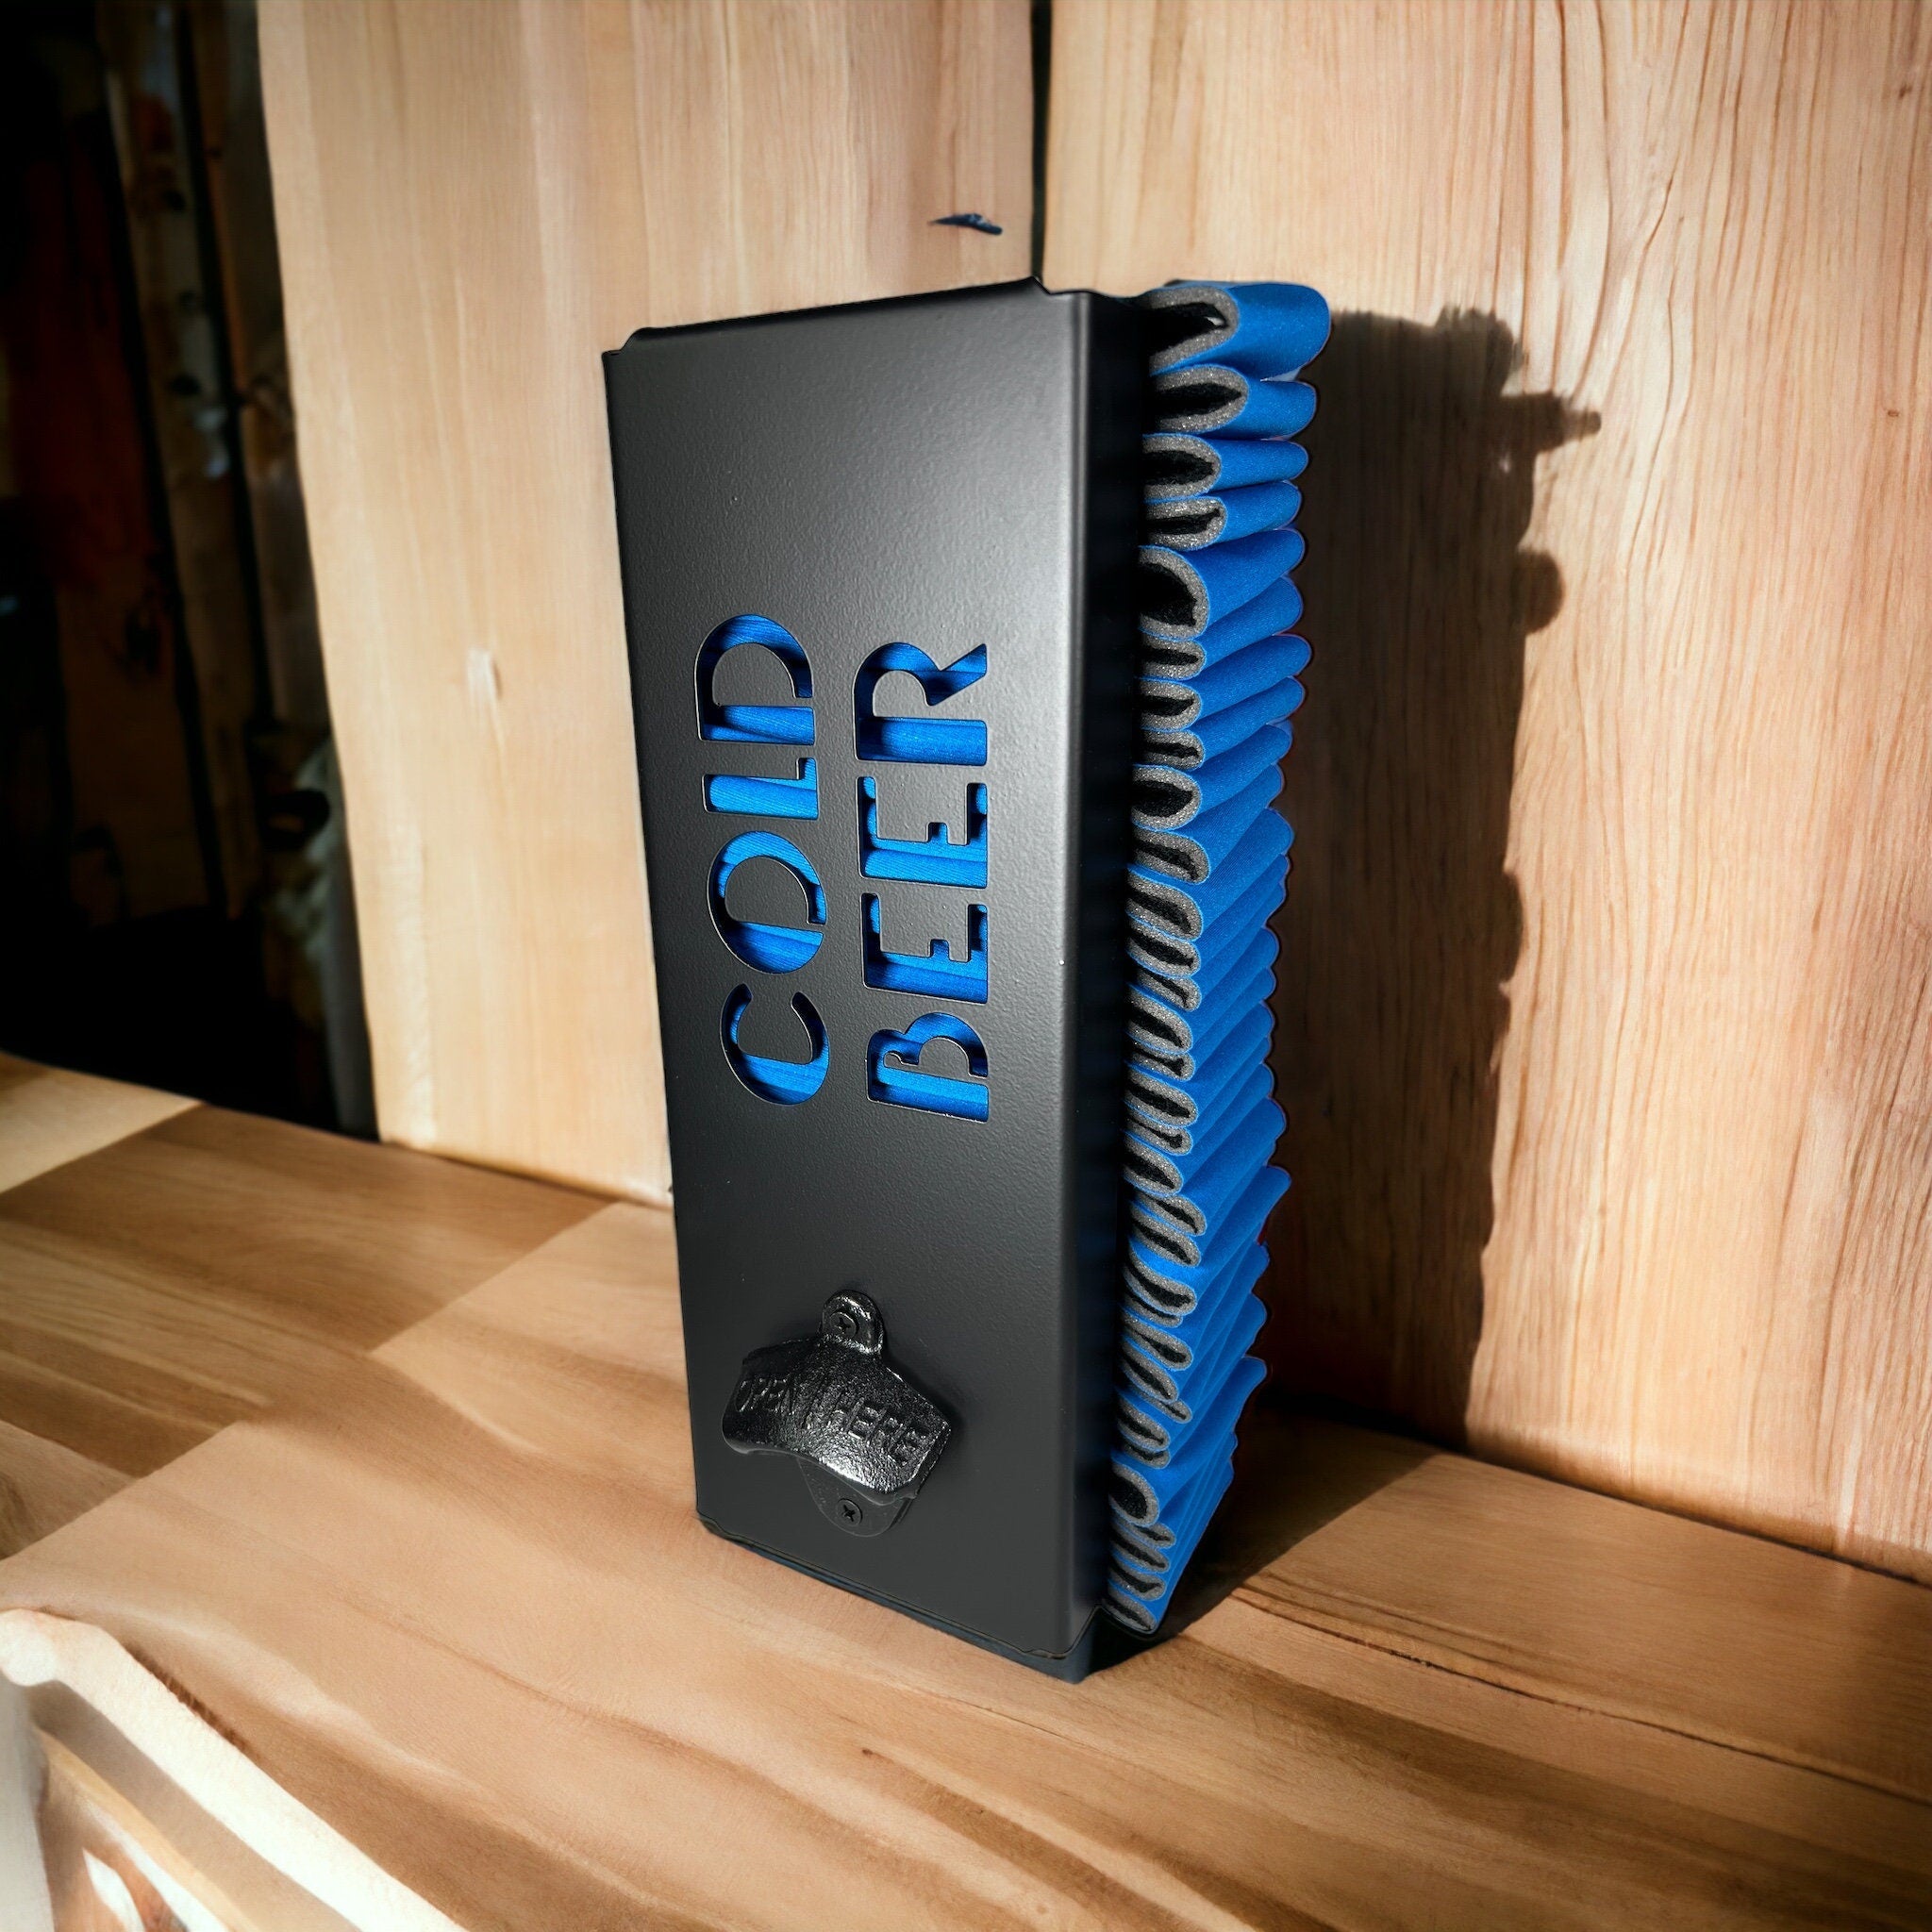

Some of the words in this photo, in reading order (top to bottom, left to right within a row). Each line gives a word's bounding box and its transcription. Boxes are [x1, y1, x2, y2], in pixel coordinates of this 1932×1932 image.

[694, 613, 830, 1106] COLD
[853, 641, 990, 1124] BEER
[733, 1374, 814, 1421] OPEN
[819, 1391, 932, 1468] HERE
